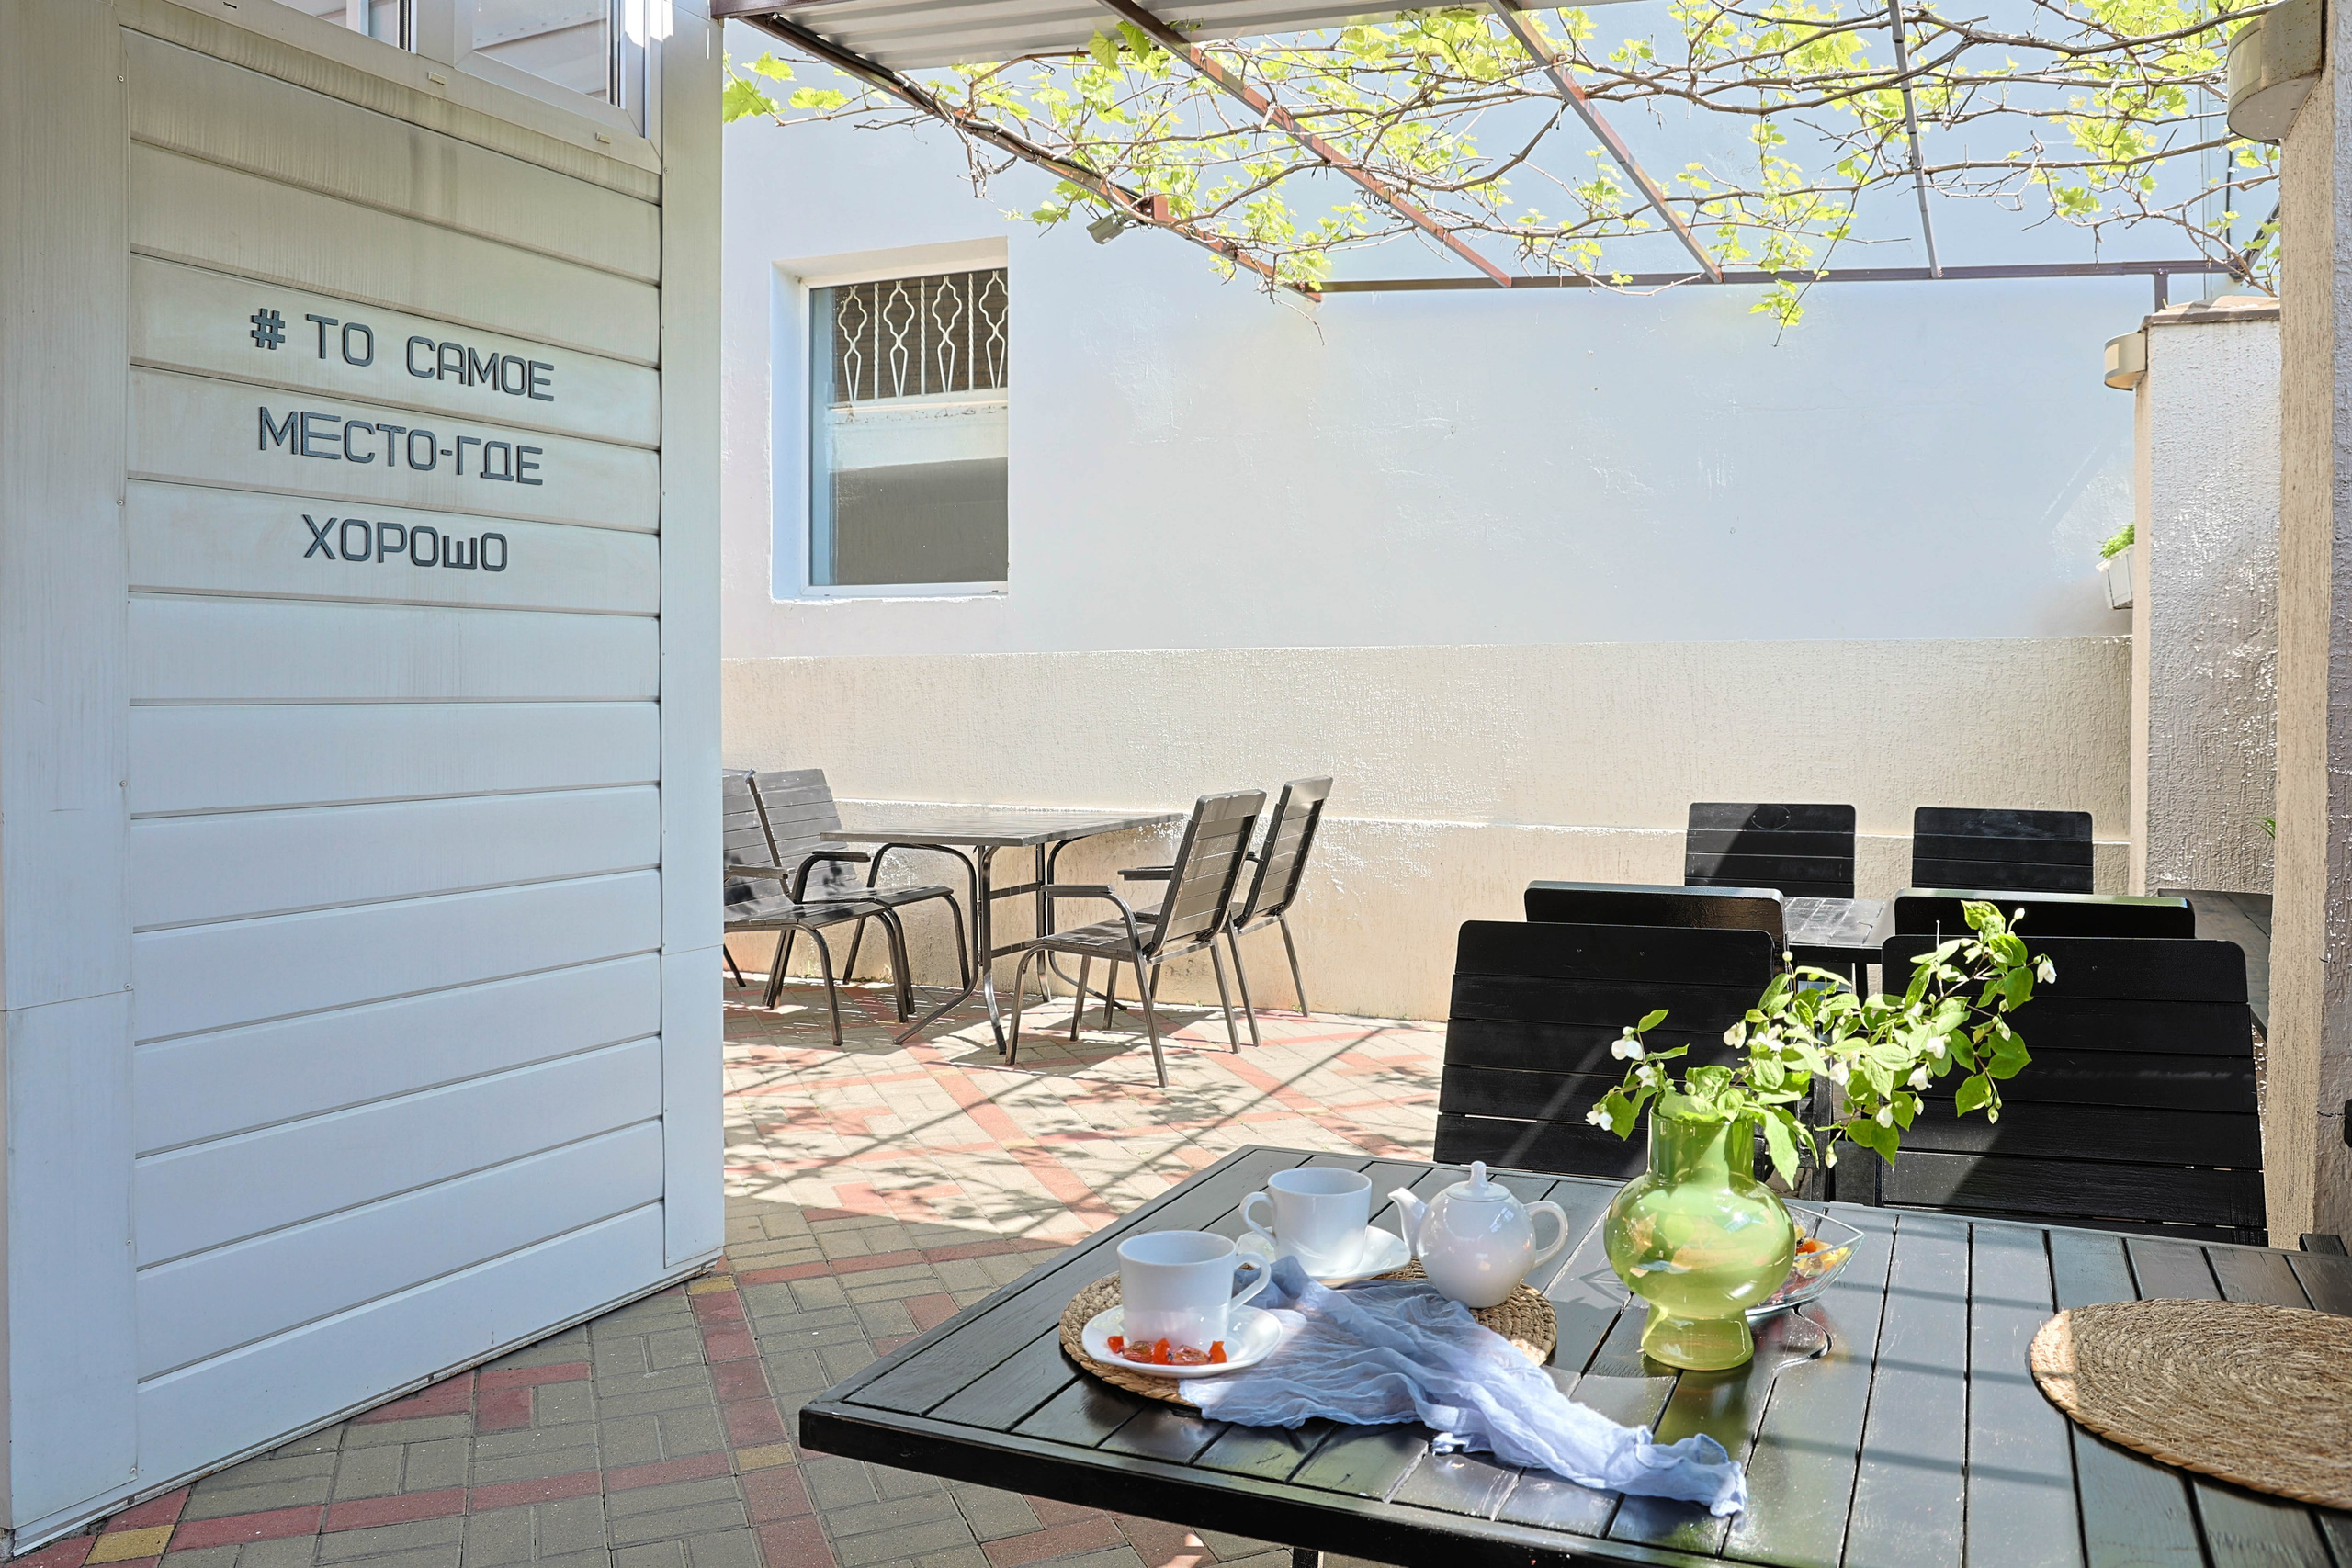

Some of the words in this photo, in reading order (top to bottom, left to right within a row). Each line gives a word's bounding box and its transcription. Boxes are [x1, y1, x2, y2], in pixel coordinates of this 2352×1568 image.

[250, 308, 286, 350] #
[304, 313, 375, 367] ТО
[406, 335, 555, 401] САМОЕ
[258, 406, 544, 486] МЕСТО-ГДЕ
